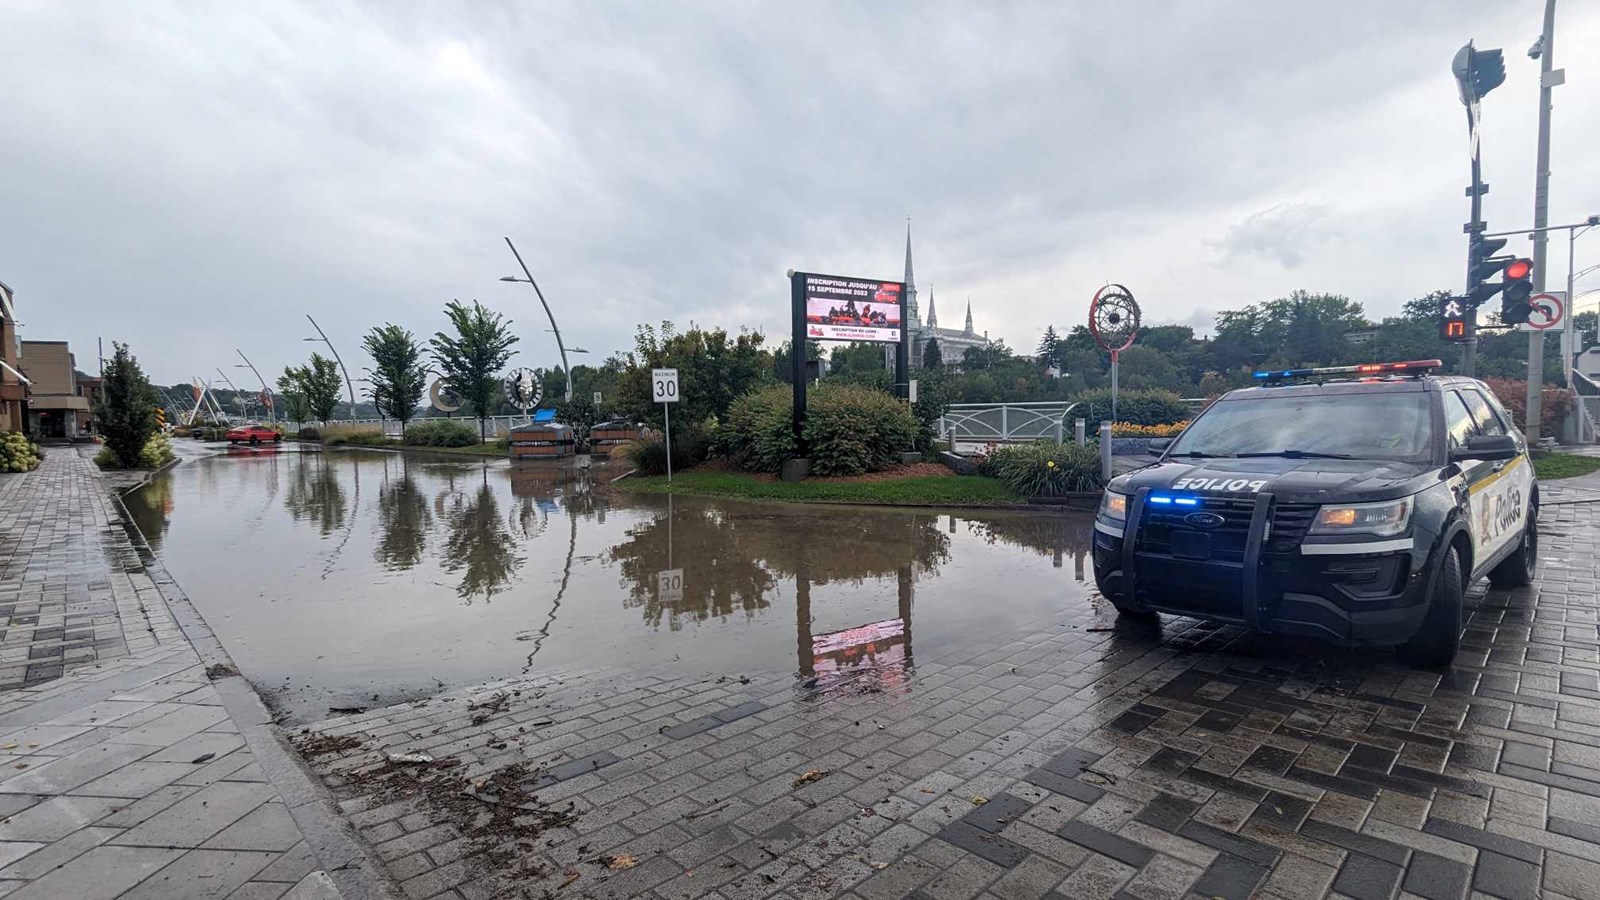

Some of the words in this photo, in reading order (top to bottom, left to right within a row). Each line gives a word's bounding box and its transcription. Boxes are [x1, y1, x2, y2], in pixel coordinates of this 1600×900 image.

[807, 278, 847, 287] INSCRIPTION
[817, 286, 853, 295] SEPTEMBRE
[656, 380, 675, 397] 30
[1494, 486, 1521, 537] Police
[1191, 514, 1215, 524] Ford
